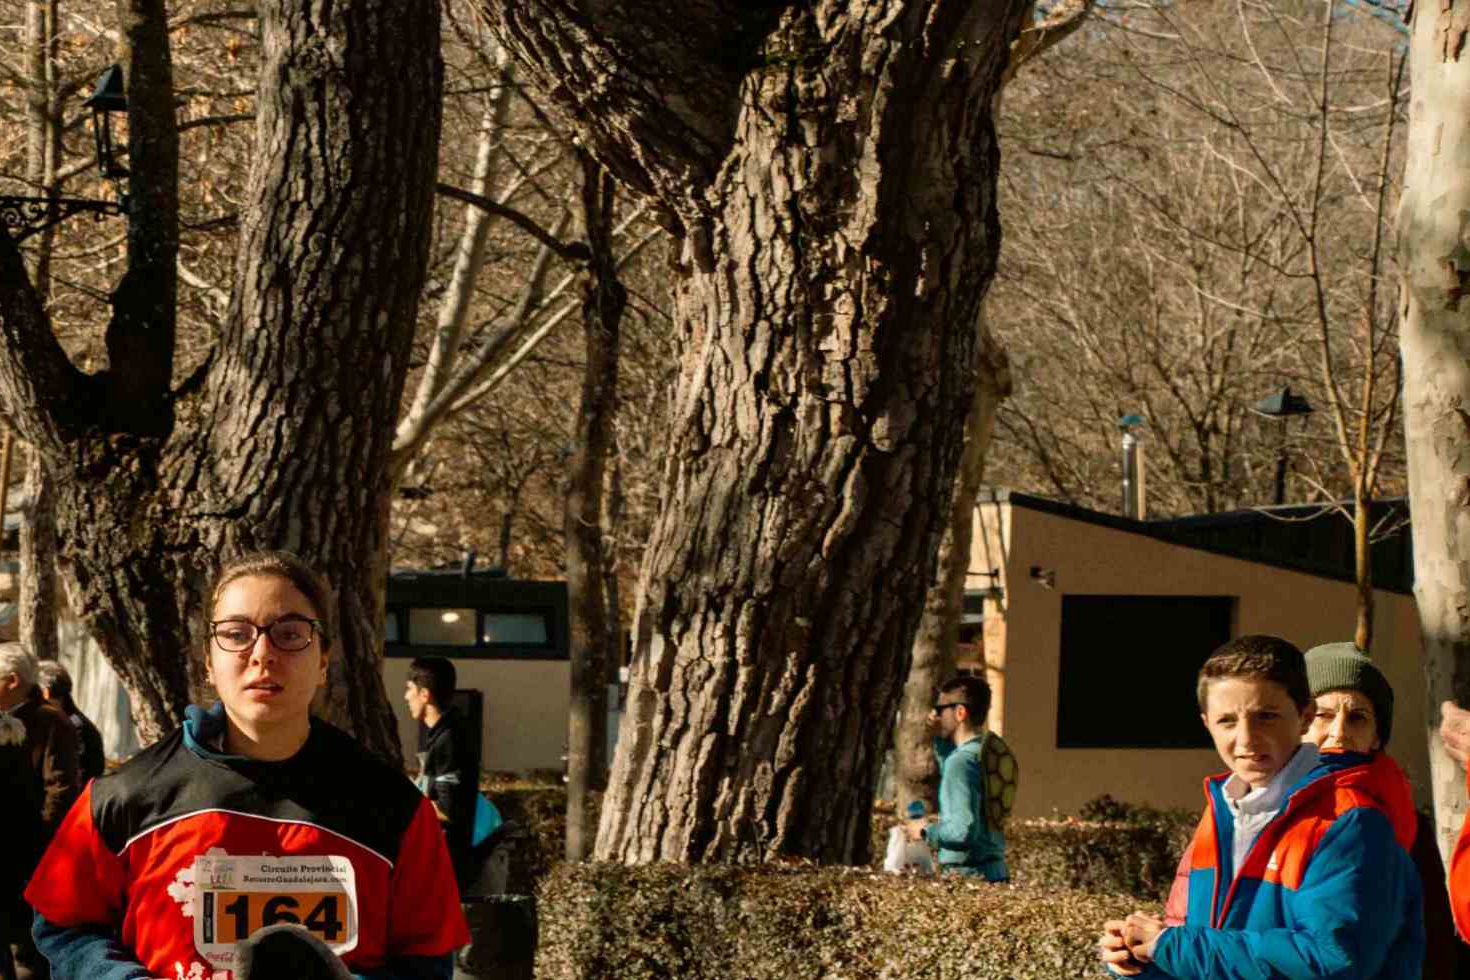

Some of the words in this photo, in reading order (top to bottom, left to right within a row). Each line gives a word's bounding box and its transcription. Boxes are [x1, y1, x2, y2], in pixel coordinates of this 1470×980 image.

[260, 864, 299, 873] Circuito
[300, 863, 347, 873] Provincial
[225, 895, 343, 941] 164
